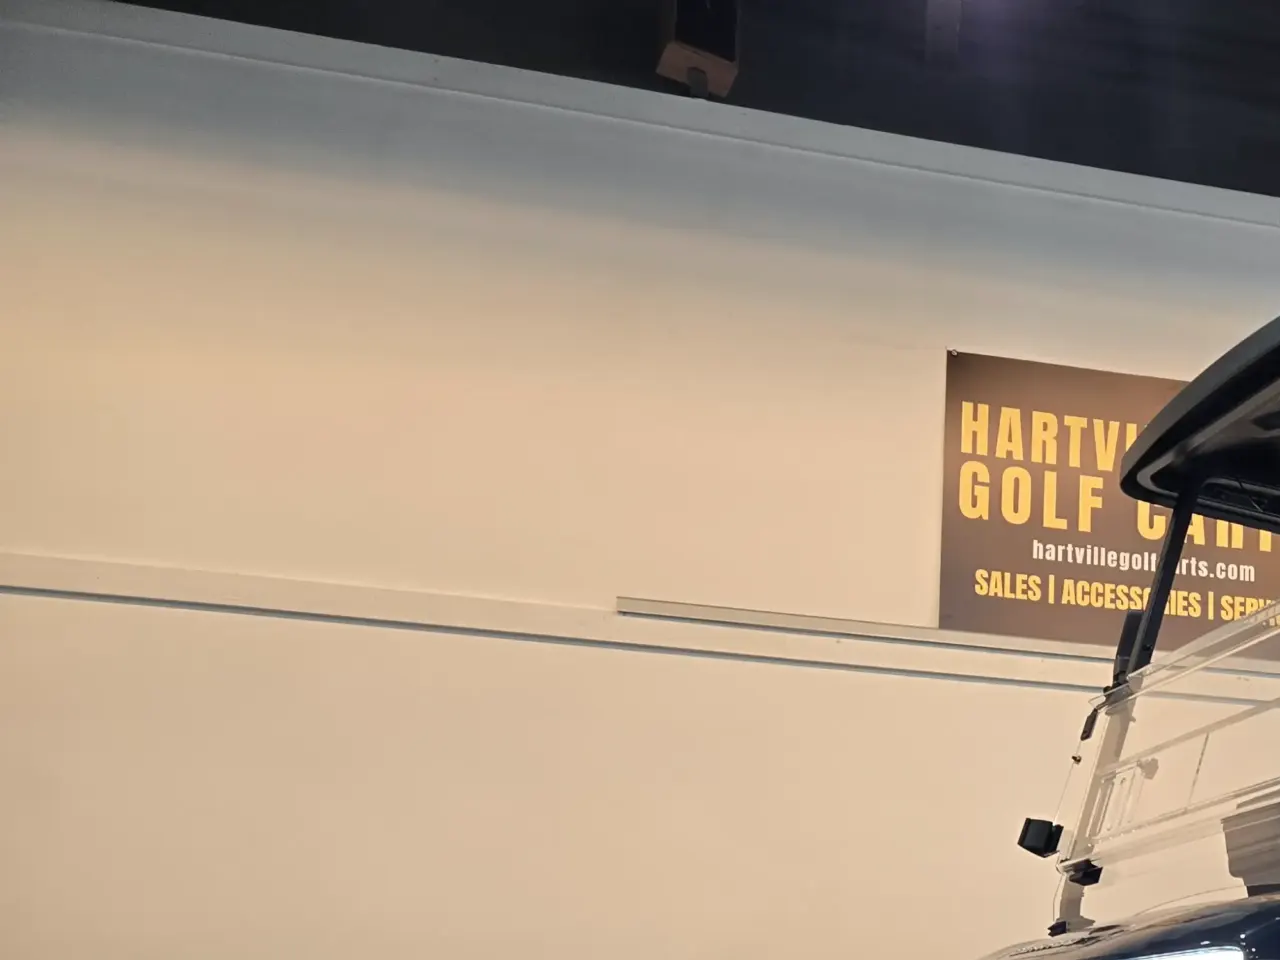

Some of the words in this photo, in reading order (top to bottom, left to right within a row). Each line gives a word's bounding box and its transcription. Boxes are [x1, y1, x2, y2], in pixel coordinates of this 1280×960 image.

[959, 460, 1104, 533] GOLF
[1032, 539, 1255, 582] hartvillegolfrts.com
[974, 568, 1042, 602] SALES
[1061, 578, 1202, 618] ACCESSIES
